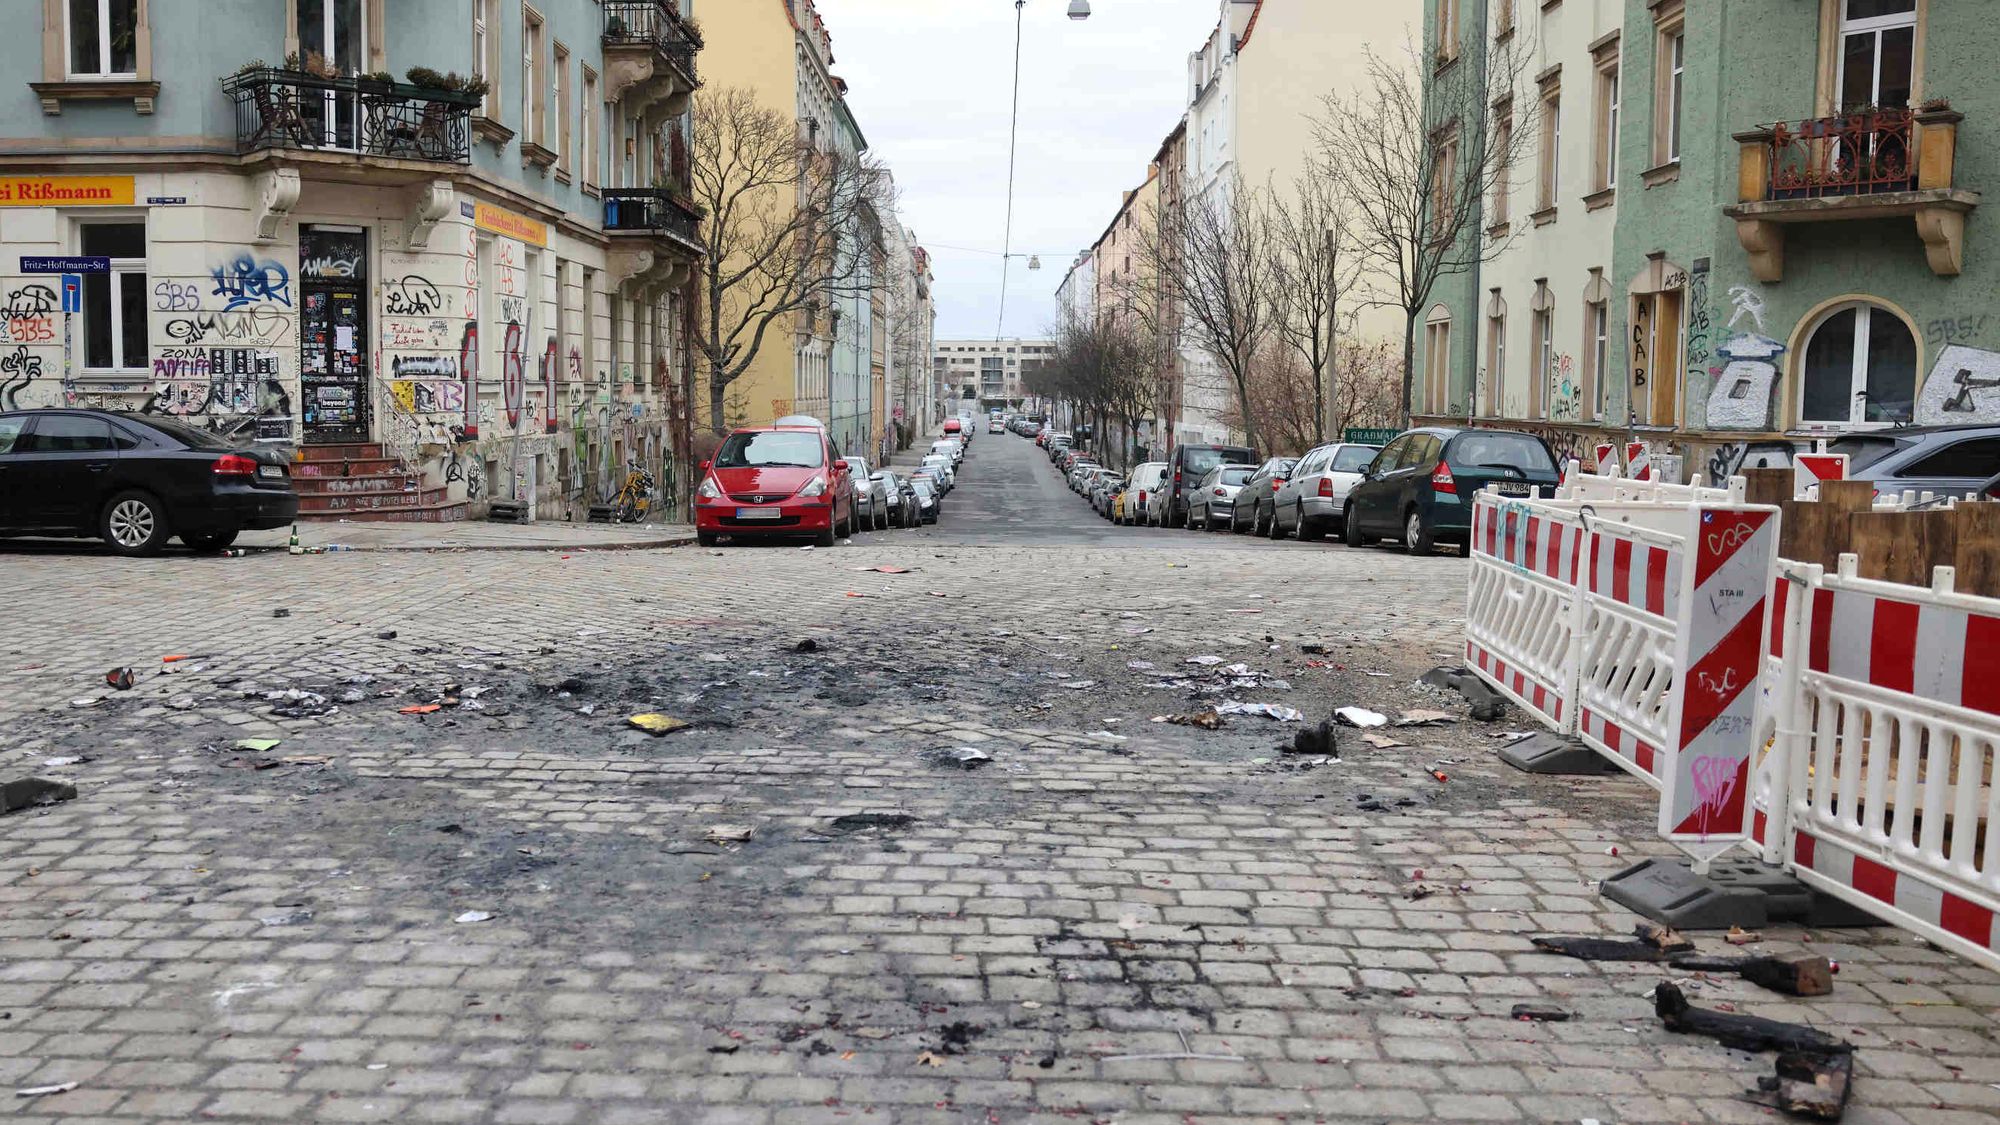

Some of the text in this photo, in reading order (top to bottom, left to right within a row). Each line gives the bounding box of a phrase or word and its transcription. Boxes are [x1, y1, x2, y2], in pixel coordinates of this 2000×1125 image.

[17, 183, 112, 200] Rißmann
[155, 280, 200, 312] SBS
[162, 347, 206, 360] ZONA
[153, 359, 212, 378] ANTIFA
[322, 398, 346, 408] beyond
[1515, 483, 1529, 492] 984
[1719, 589, 1735, 597] STA
